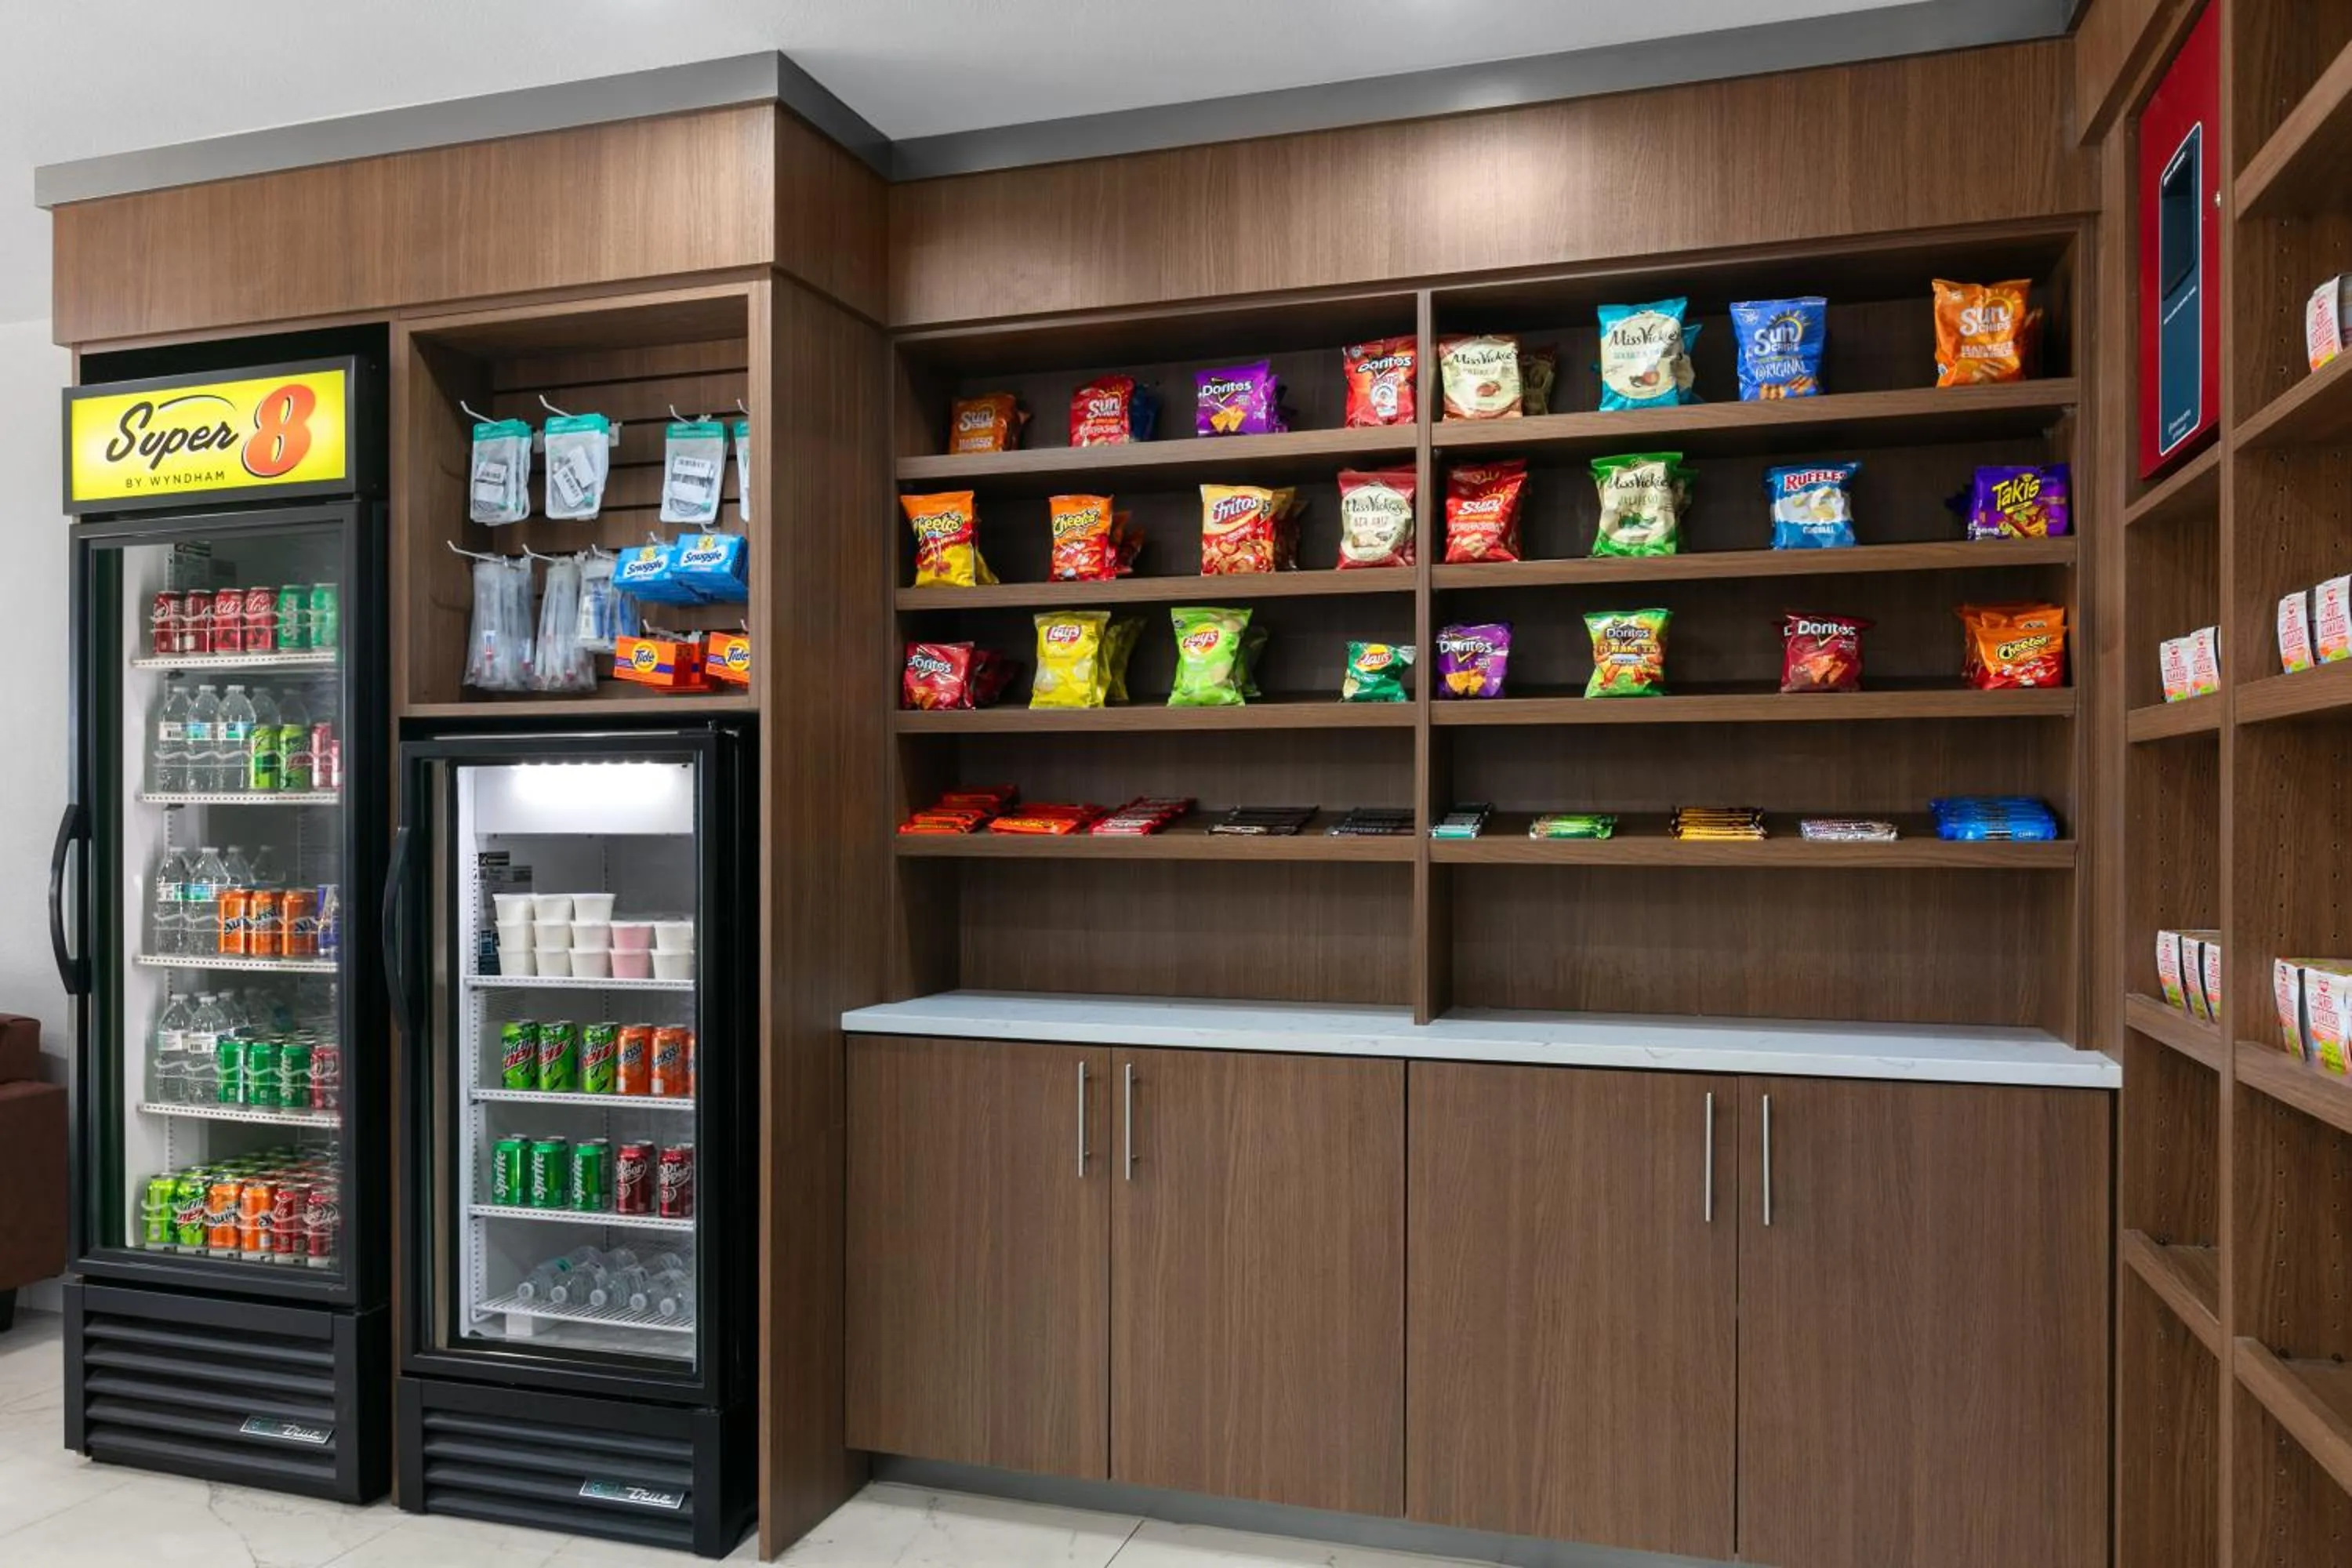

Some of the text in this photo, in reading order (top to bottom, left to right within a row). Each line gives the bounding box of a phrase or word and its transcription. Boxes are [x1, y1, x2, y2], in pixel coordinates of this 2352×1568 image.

[1959, 306, 2009, 337] Sun
[1754, 325, 1798, 356] Sun
[1356, 355, 1412, 373] Doritos
[1201, 379, 1252, 397] Doritos
[1086, 397, 1120, 419] Sun
[106, 383, 316, 478] Super 8
[125, 470, 226, 488] BY WYNDHAM
[1784, 470, 1848, 492] RUFFLES
[1991, 474, 2041, 512] Takis
[1212, 495, 1261, 524] Fritos
[627, 561, 664, 575] Snuggle
[684, 550, 722, 564] Snuggle
[1606, 627, 1650, 638] Doritos
[1798, 619, 1857, 637] Doritos
[634, 648, 655, 662] Tide
[1439, 638, 1494, 654] Doritos
[1996, 634, 2051, 660] Cheetos
[494, 1150, 507, 1198] Sprite
[533, 1152, 546, 1200] Sprite
